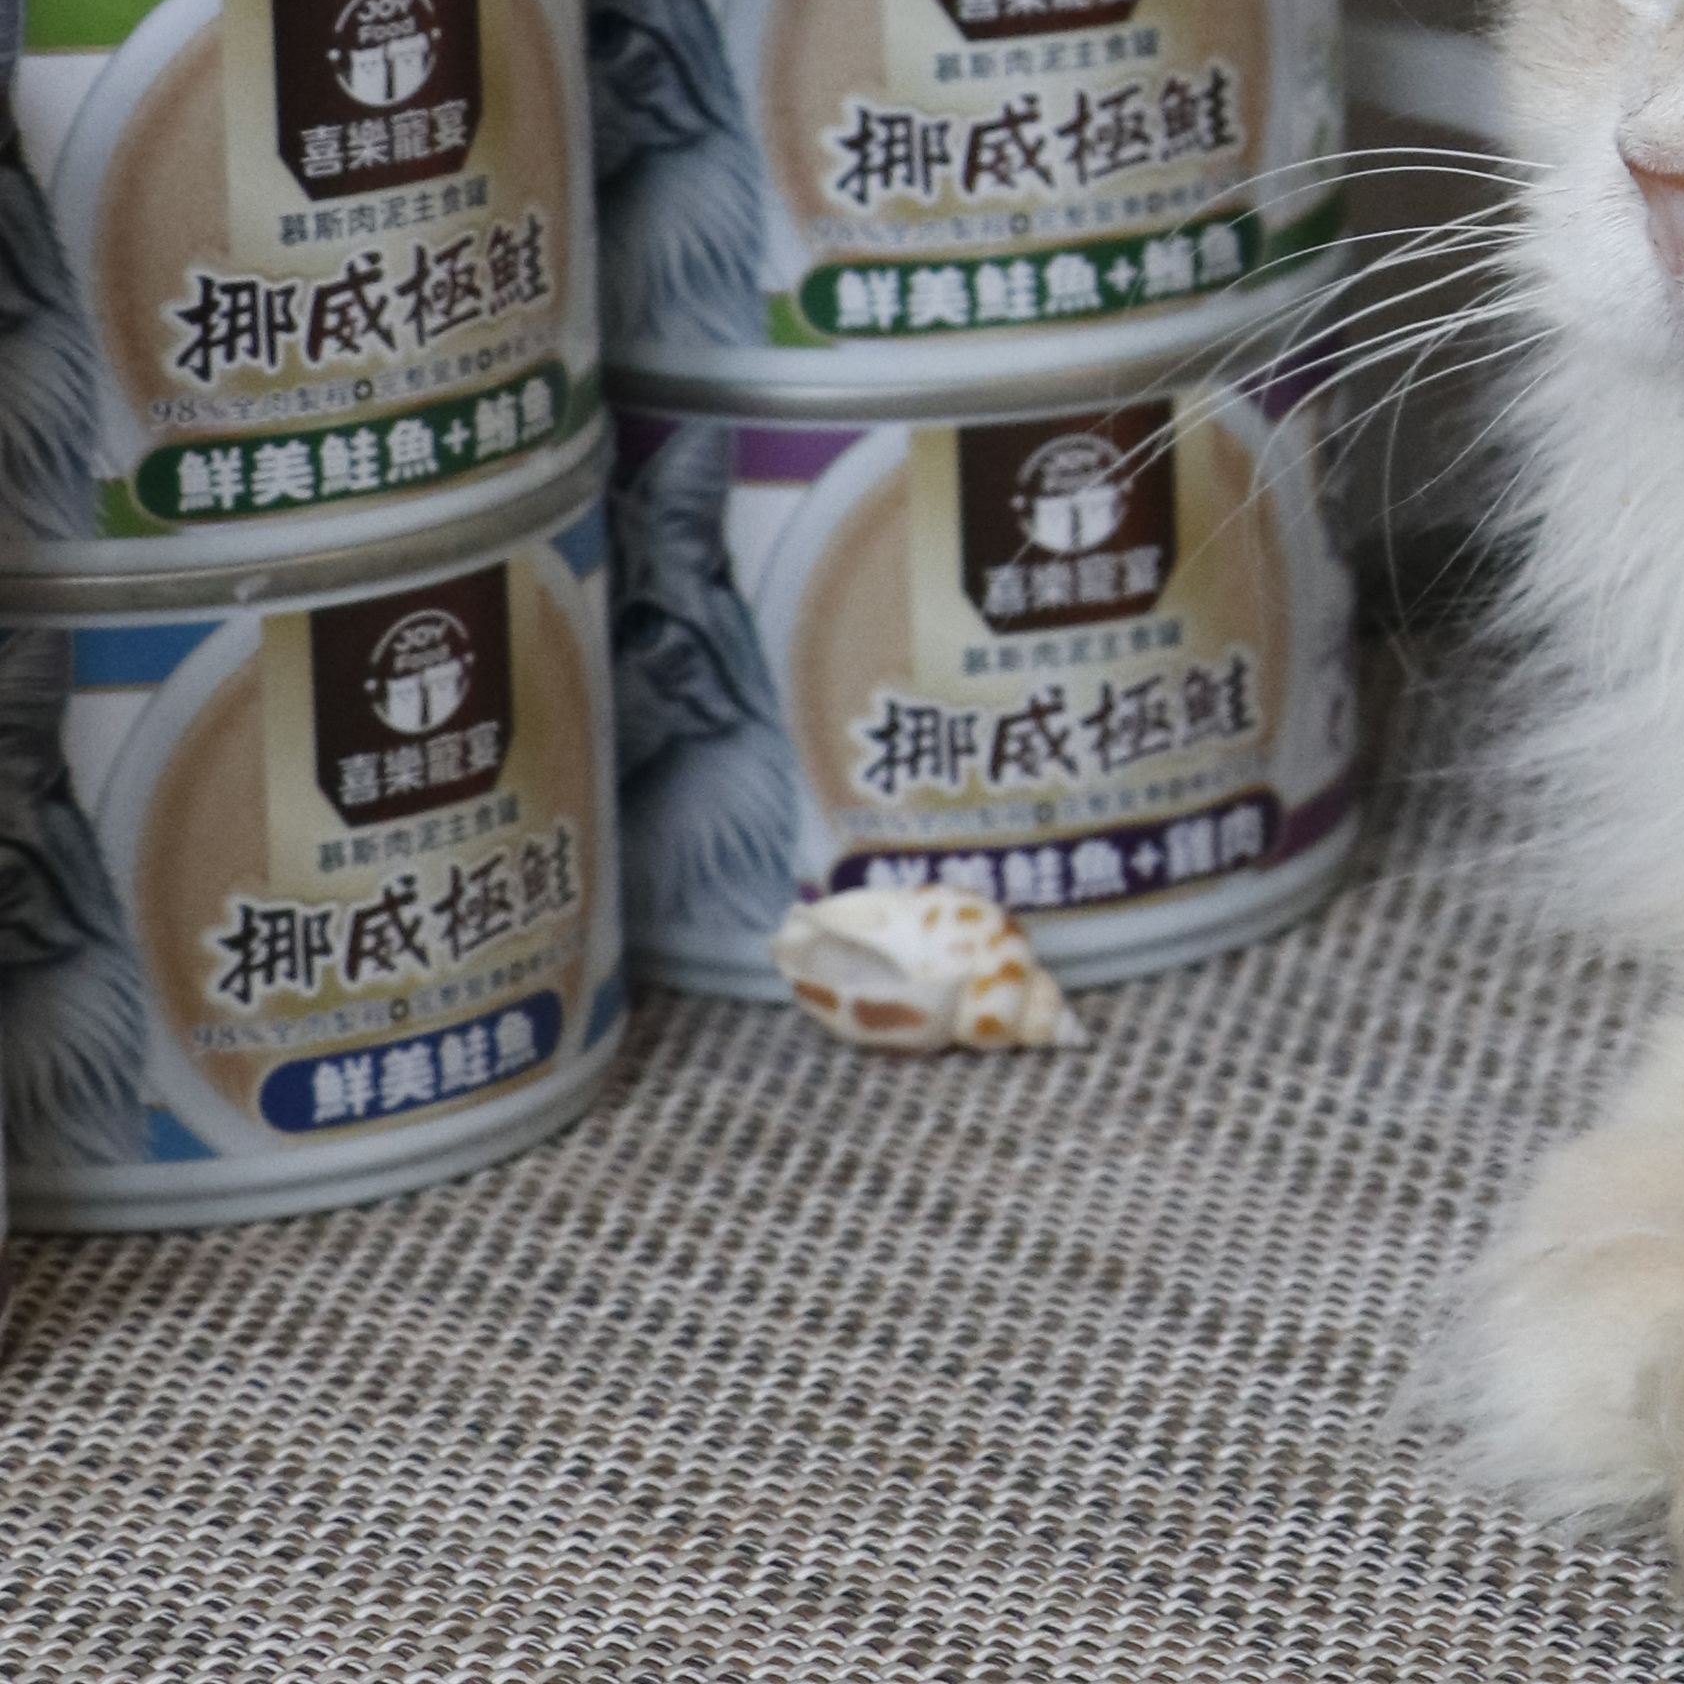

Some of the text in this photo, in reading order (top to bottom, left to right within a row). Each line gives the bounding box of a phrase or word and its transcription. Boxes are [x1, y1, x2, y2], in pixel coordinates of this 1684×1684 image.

[301, 100, 469, 177] 喜樂寵宴
[835, 67, 1236, 204] 挪威極鮭
[177, 214, 547, 381] 挪威極鮭
[865, 654, 1252, 793] 挪威極鮭
[220, 826, 574, 1003] 挪威極鮭
[313, 1012, 537, 1122] 鮮美鮭魚
